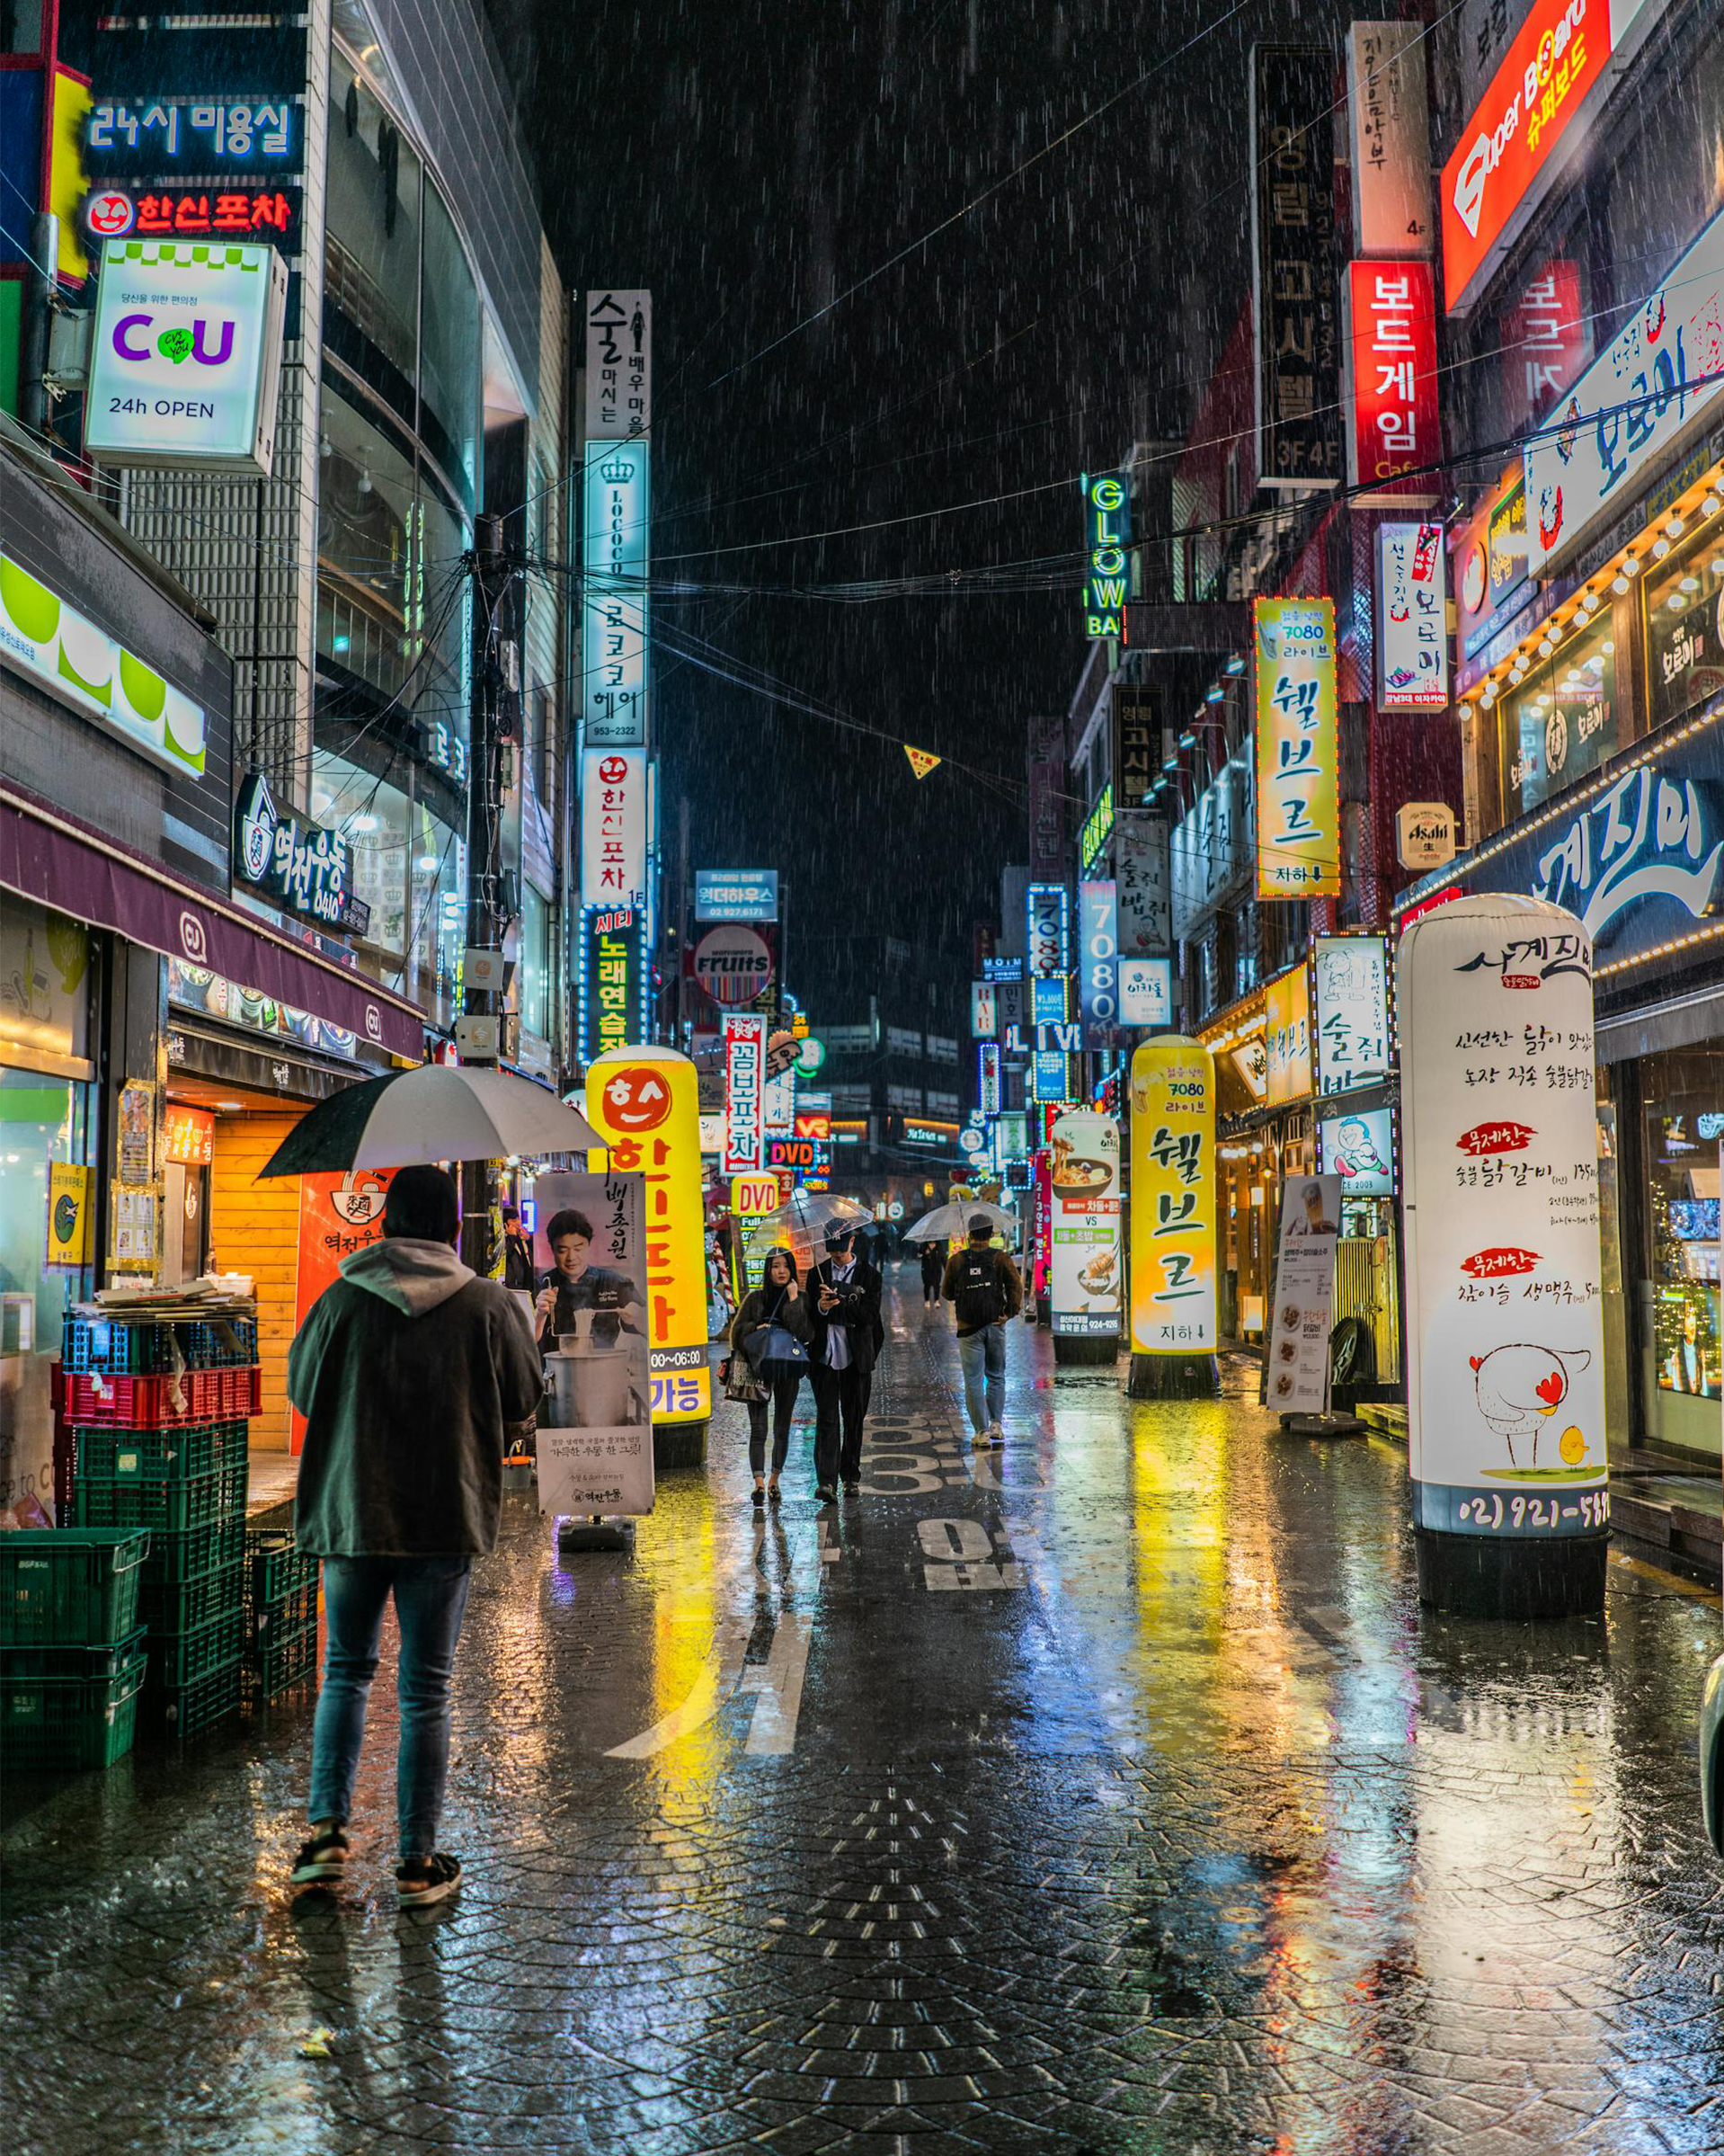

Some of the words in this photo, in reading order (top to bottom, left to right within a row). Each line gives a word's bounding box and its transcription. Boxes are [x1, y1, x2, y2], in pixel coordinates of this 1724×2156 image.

[1527, 32, 1587, 153] 슈퍼보드
[91, 105, 177, 153] 24시
[191, 105, 289, 153] 미용실
[1453, 92, 1522, 238] Super
[137, 192, 291, 232] 한신포차
[1407, 220, 1426, 236] 4F
[121, 293, 148, 305] 당신을
[151, 295, 169, 305] 위한
[171, 296, 198, 306] 편의점
[590, 293, 627, 364] 술
[1275, 261, 1313, 420] 고시텔
[628, 356, 644, 392] 배우
[1370, 276, 1417, 451] 보드게임
[109, 397, 147, 414] 24h
[155, 400, 214, 418] OPEN
[600, 370, 618, 423] 마시는
[1277, 441, 1304, 467] 3F
[1309, 441, 1338, 467] 4F
[610, 490, 623, 576] LOCOCO
[1091, 479, 1126, 610] GLOW
[1087, 614, 1121, 636] BA
[1283, 624, 1325, 641] 7080
[606, 605, 624, 687] 로코코
[1283, 644, 1332, 660] 라이브
[593, 692, 636, 719] 헤어
[593, 726, 636, 736] 953-2322
[1272, 676, 1322, 843] 쉘브르
[600, 788, 627, 891] 한신포차
[1408, 824, 1448, 841] Asahi
[1423, 842, 1435, 852] 生
[275, 819, 347, 911] 역전우동
[1275, 866, 1308, 883] 지하
[315, 888, 341, 921] 0410
[628, 889, 644, 904] 1F
[594, 909, 633, 935] 시티
[185, 923, 200, 950] CU
[1090, 904, 1115, 1019] 7080
[369, 1016, 379, 1032] CU
[1455, 1030, 1514, 1048] 신선한
[1524, 1024, 1562, 1056] 닭이
[1168, 1082, 1205, 1097] 7080
[1463, 1065, 1500, 1087] 농장
[1507, 1065, 1538, 1087] 직송
[1165, 1102, 1207, 1114] 라이브
[796, 1118, 829, 1138] VR
[1470, 1126, 1525, 1154] 무제한
[771, 1143, 813, 1164] DVD
[1355, 1179, 1373, 1189] 2003
[740, 1184, 776, 1212] DVD
[605, 1182, 629, 1260] 백종원
[1085, 1216, 1097, 1226] VS
[1150, 1128, 1205, 1302] 쉘브르
[1474, 1251, 1528, 1278] 무제한
[1458, 1283, 1510, 1305] 참이슬
[1523, 1280, 1573, 1305] 생맥주
[1160, 1325, 1193, 1341] 지하
